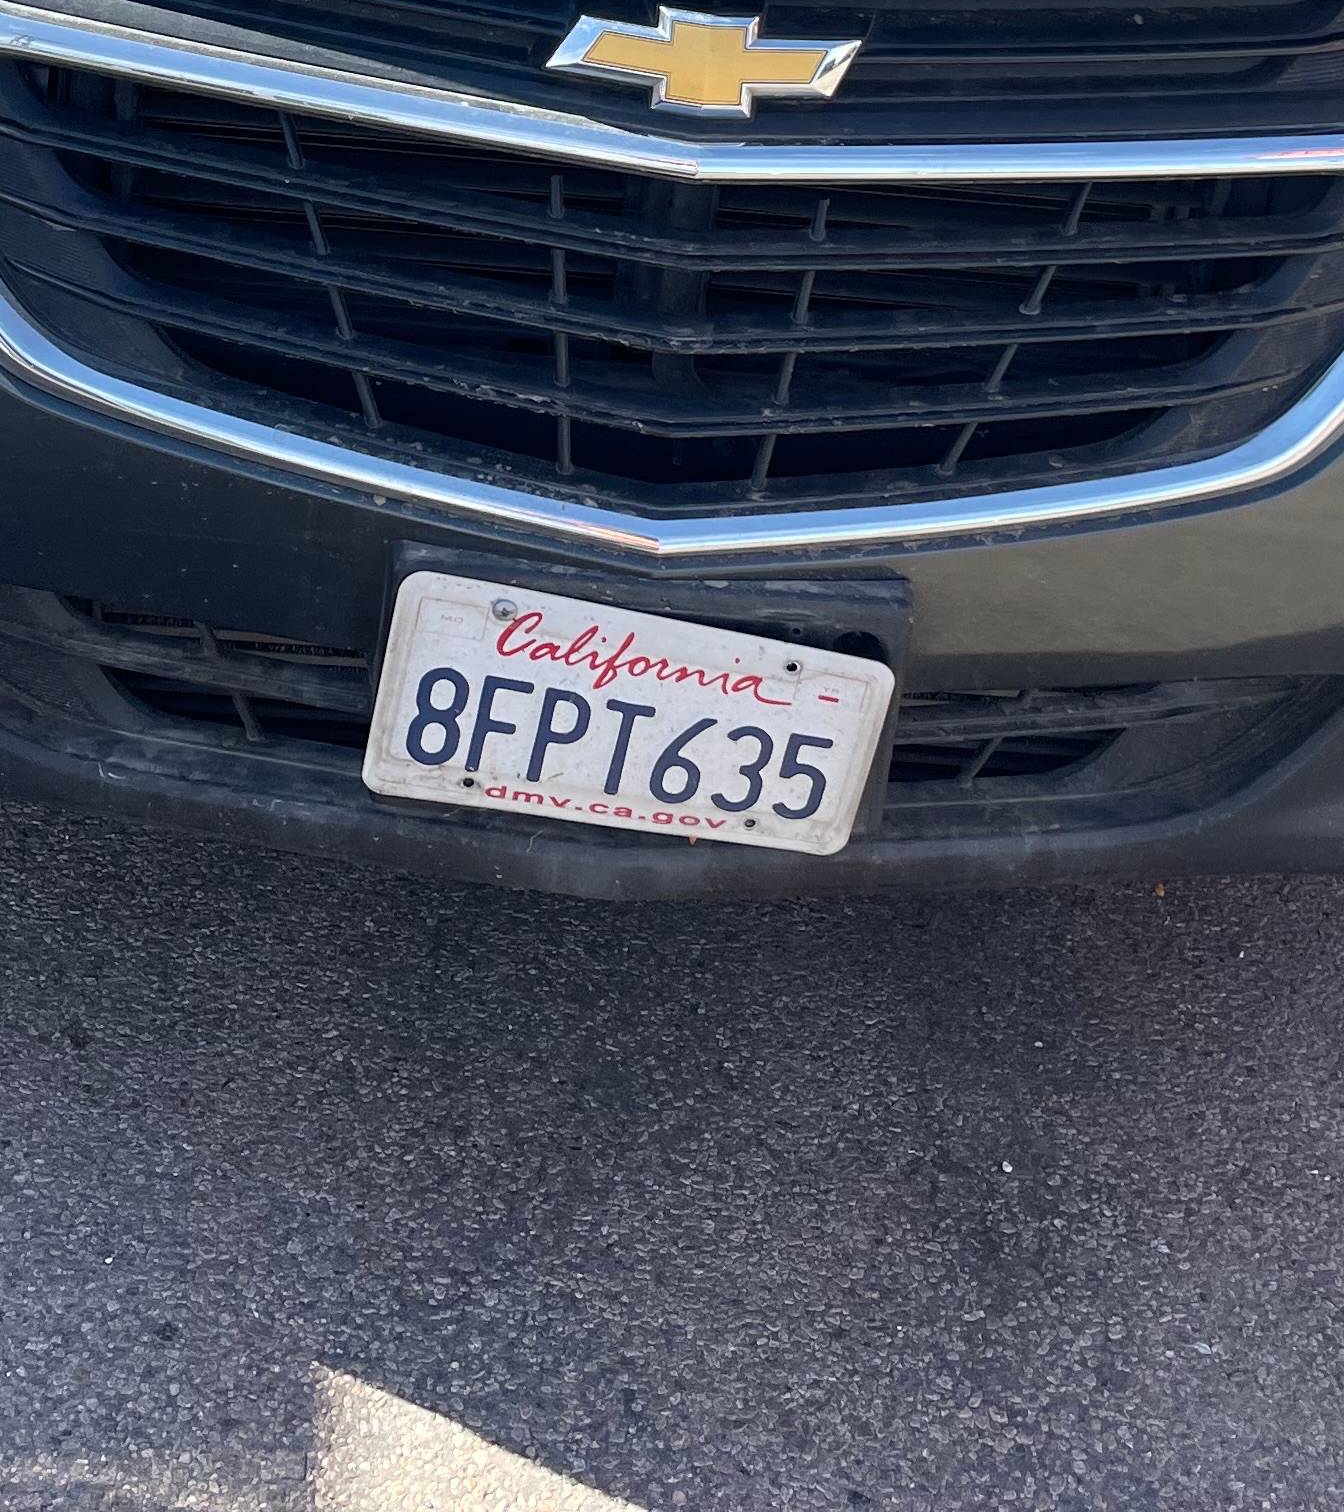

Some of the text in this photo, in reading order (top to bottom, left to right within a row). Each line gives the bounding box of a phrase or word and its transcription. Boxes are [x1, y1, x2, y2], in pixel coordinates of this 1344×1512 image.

[495, 611, 793, 706] California
[405, 666, 835, 820] 8FPT635
[484, 784, 727, 830] dmv.ca.gov
